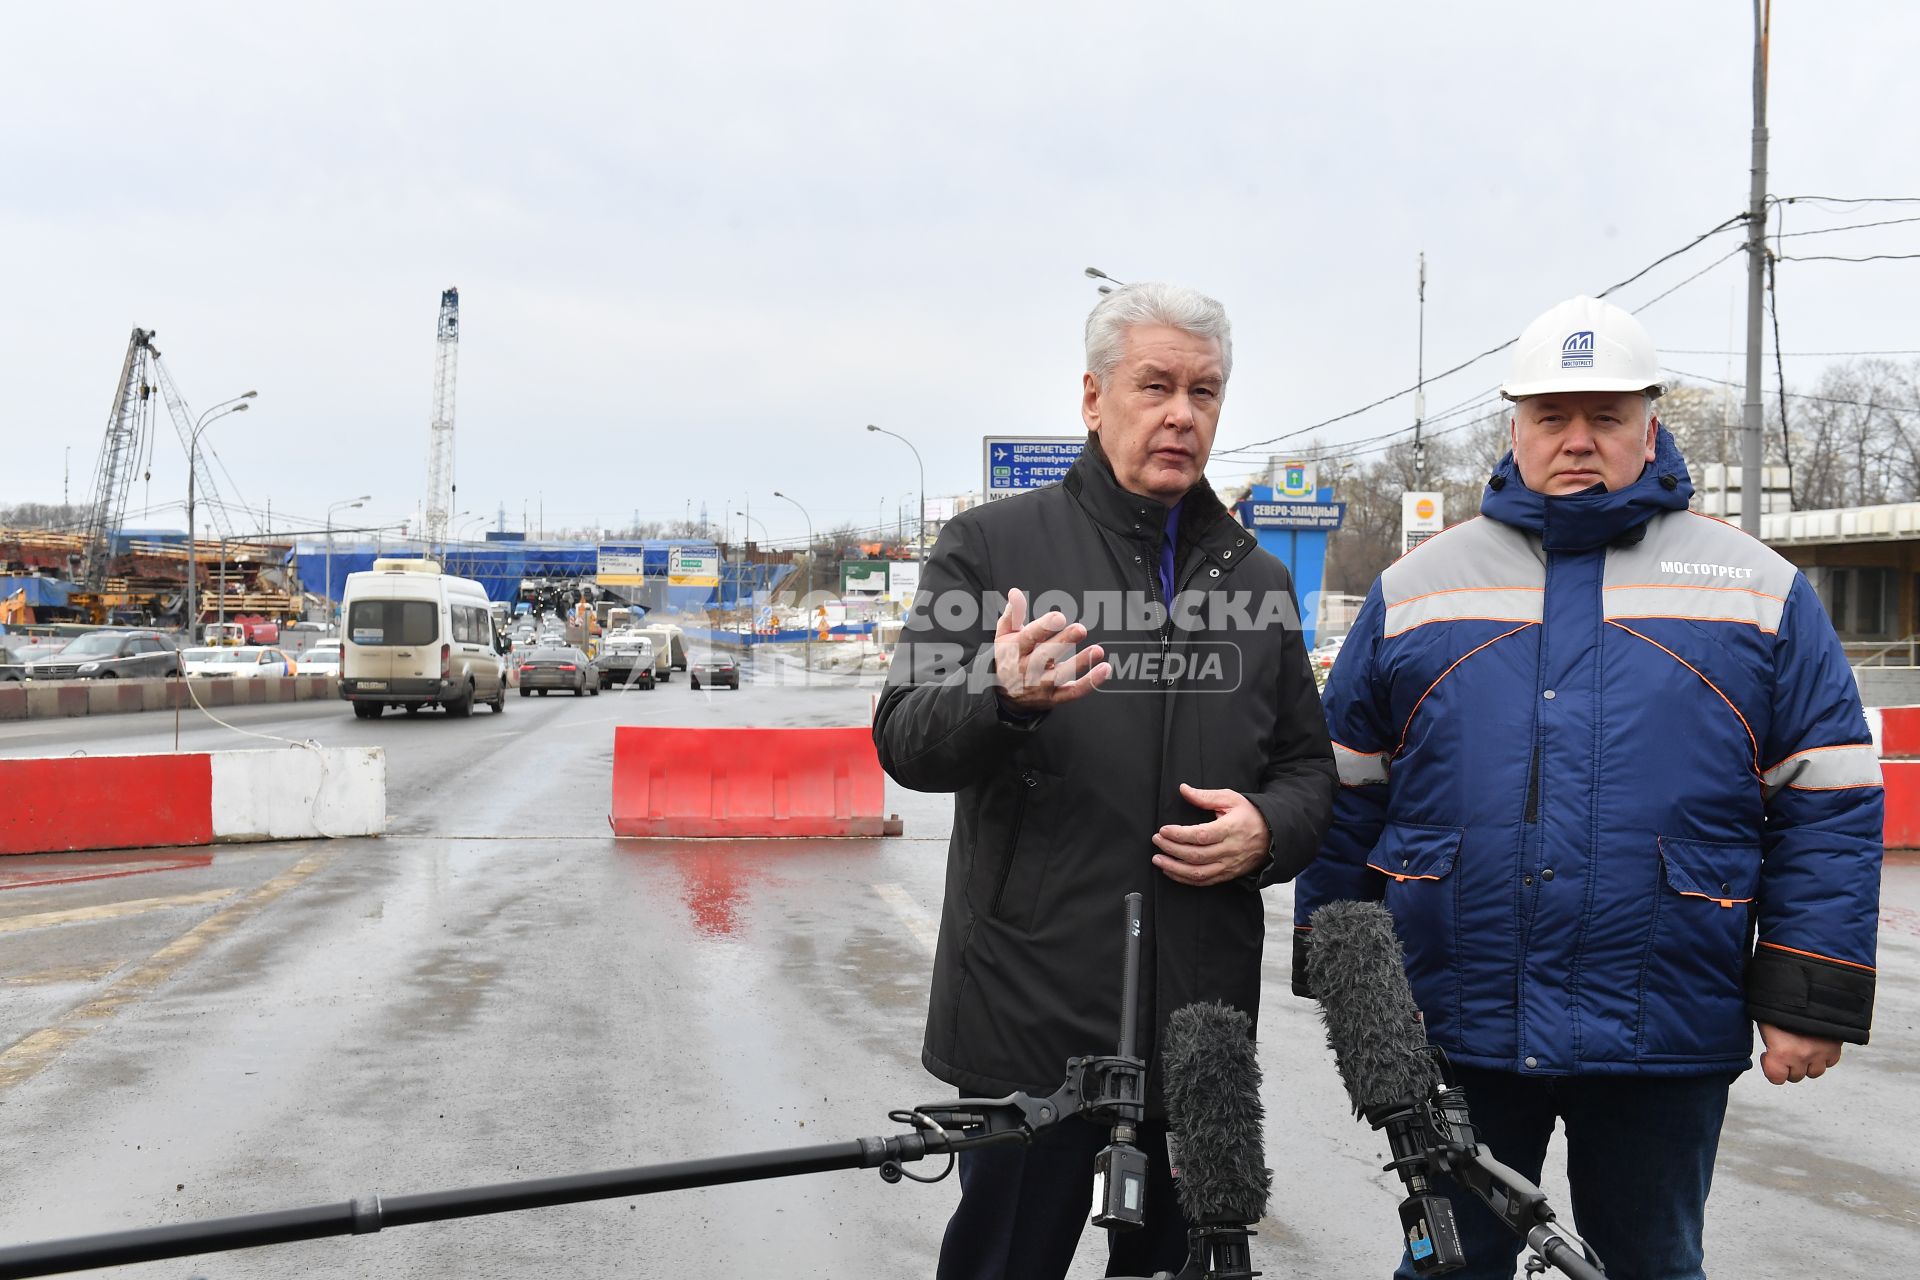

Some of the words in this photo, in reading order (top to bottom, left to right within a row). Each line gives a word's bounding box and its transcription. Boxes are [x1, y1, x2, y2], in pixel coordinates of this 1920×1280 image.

[1013, 455, 1075, 464] Sheremetyevo
[1253, 504, 1339, 517] СЕВЕРО-ЗАПАДНЫЙ
[1660, 561, 1753, 578] МОСТОТРЕСТ
